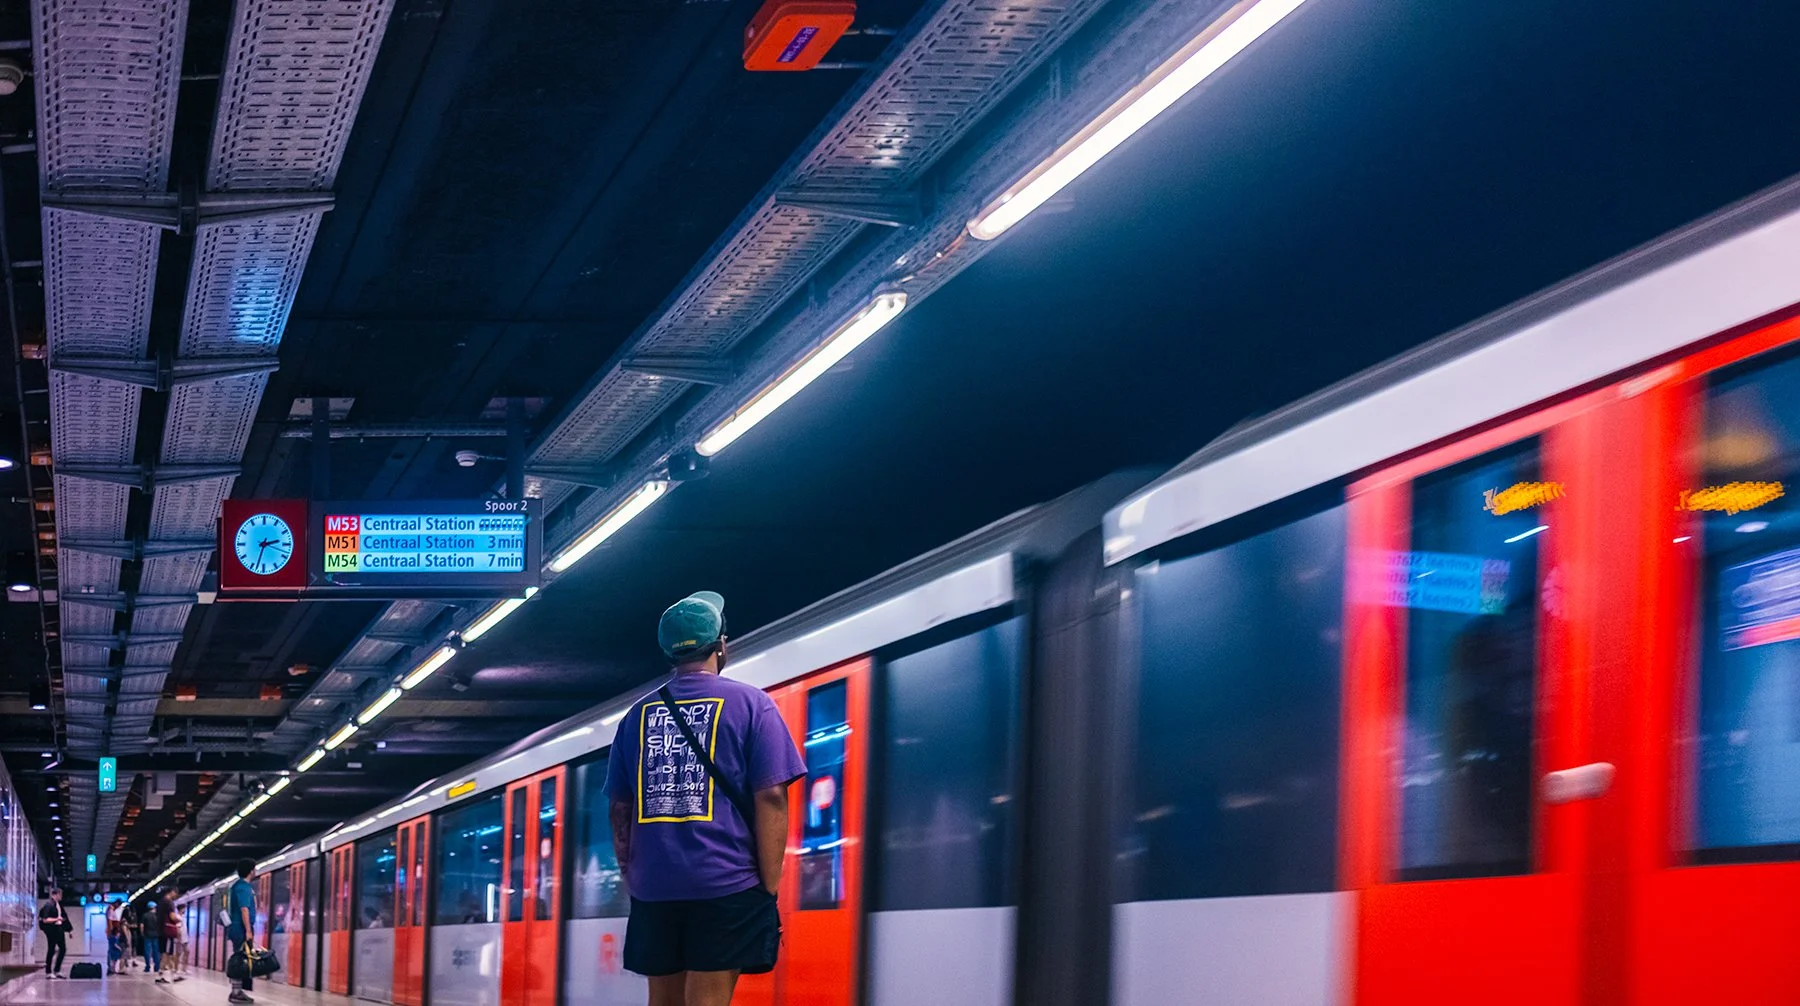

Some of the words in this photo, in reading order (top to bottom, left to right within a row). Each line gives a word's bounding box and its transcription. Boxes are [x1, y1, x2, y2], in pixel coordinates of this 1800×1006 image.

[485, 500, 518, 513] Spoor
[520, 500, 528, 511] 2
[328, 516, 359, 531] M53
[364, 516, 421, 531] Centraal
[425, 517, 475, 531] Station
[328, 536, 356, 549] M51
[364, 535, 420, 549] Centraal
[425, 535, 475, 549] Station
[488, 535, 496, 549] 3
[498, 535, 523, 549] min
[328, 554, 357, 568] M54
[363, 553, 420, 568] Centraal
[425, 554, 474, 568] Station
[488, 554, 496, 568] 7
[498, 553, 523, 568] min
[656, 704, 713, 717] DNDY
